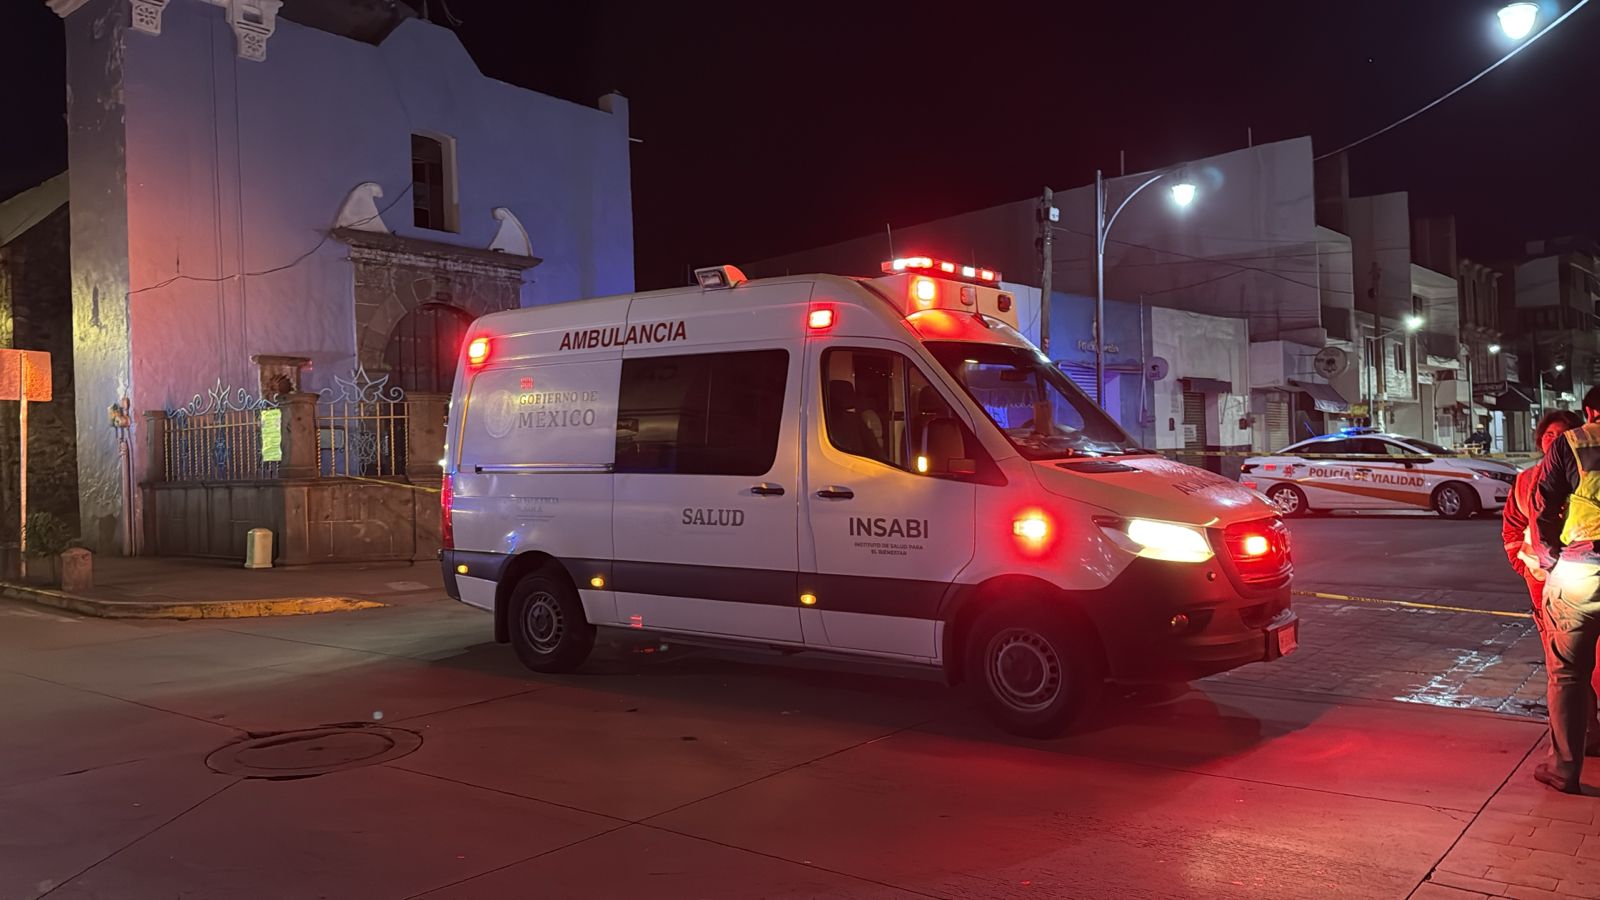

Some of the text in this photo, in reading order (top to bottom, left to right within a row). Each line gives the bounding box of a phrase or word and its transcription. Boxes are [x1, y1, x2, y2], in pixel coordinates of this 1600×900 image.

[559, 320, 687, 351] AMBULANCIA
[519, 390, 598, 406] GOBIERNO DE
[518, 405, 596, 429] MÉXICO
[1309, 467, 1425, 487] POLICÍA DE VIALIDAD
[682, 508, 745, 527] SALUD
[849, 517, 929, 539] INSABI
